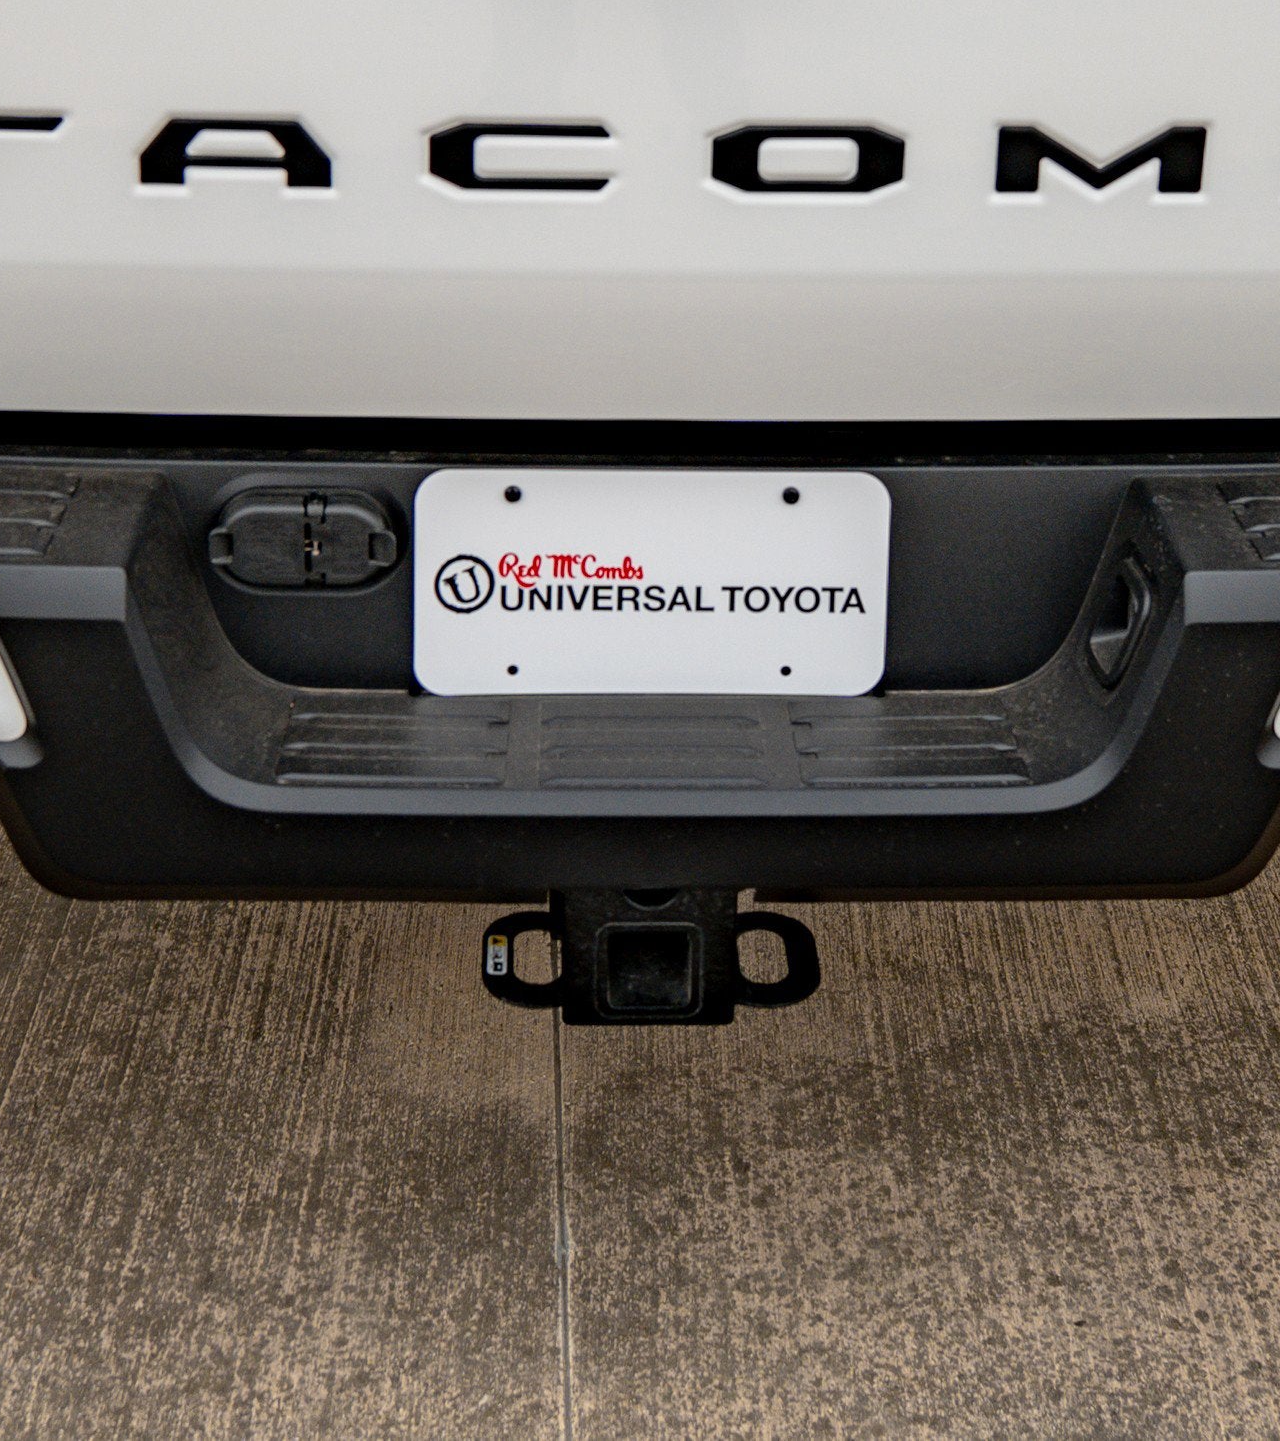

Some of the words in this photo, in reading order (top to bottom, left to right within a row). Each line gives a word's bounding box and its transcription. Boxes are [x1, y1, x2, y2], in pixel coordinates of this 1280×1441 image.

[498, 552, 542, 588] Red
[499, 584, 715, 612] UNIVERSAL
[722, 585, 866, 614] TOYOTA
